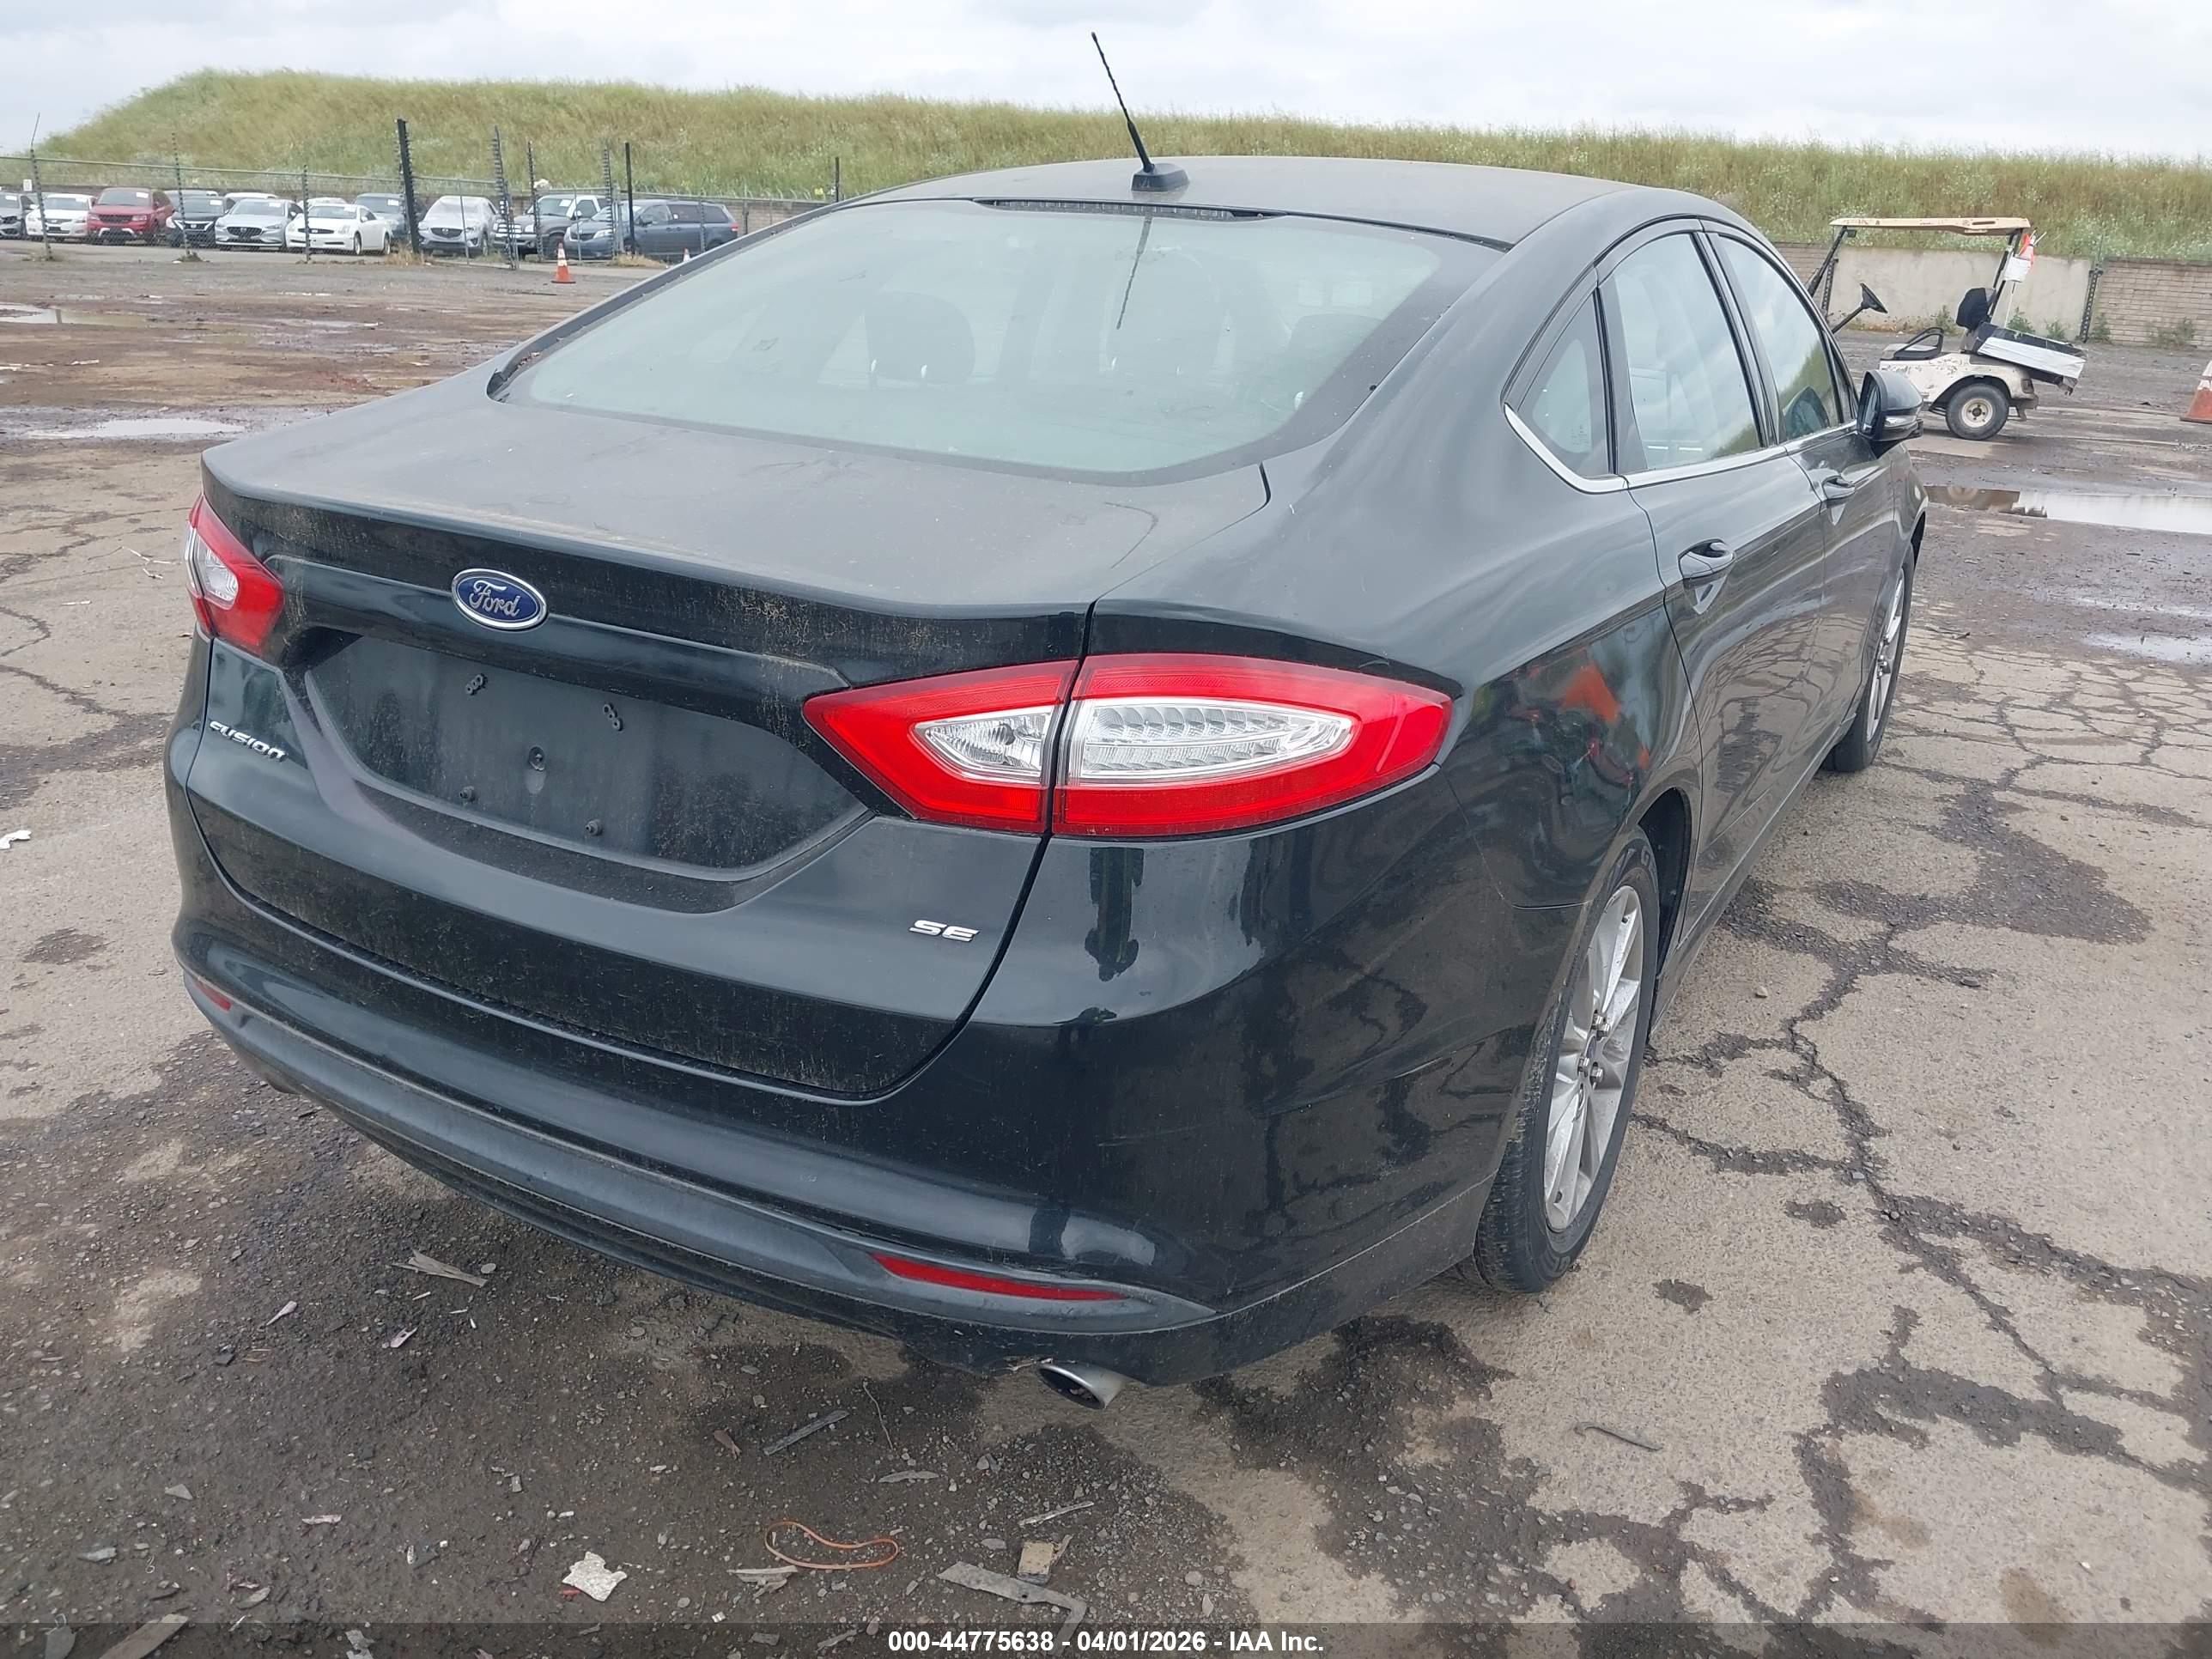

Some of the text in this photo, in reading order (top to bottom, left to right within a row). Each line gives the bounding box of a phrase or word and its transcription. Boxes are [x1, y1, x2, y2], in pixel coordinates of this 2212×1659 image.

[469, 580, 521, 617] Ford
[209, 720, 287, 759] FUSION
[908, 920, 980, 942] SE
